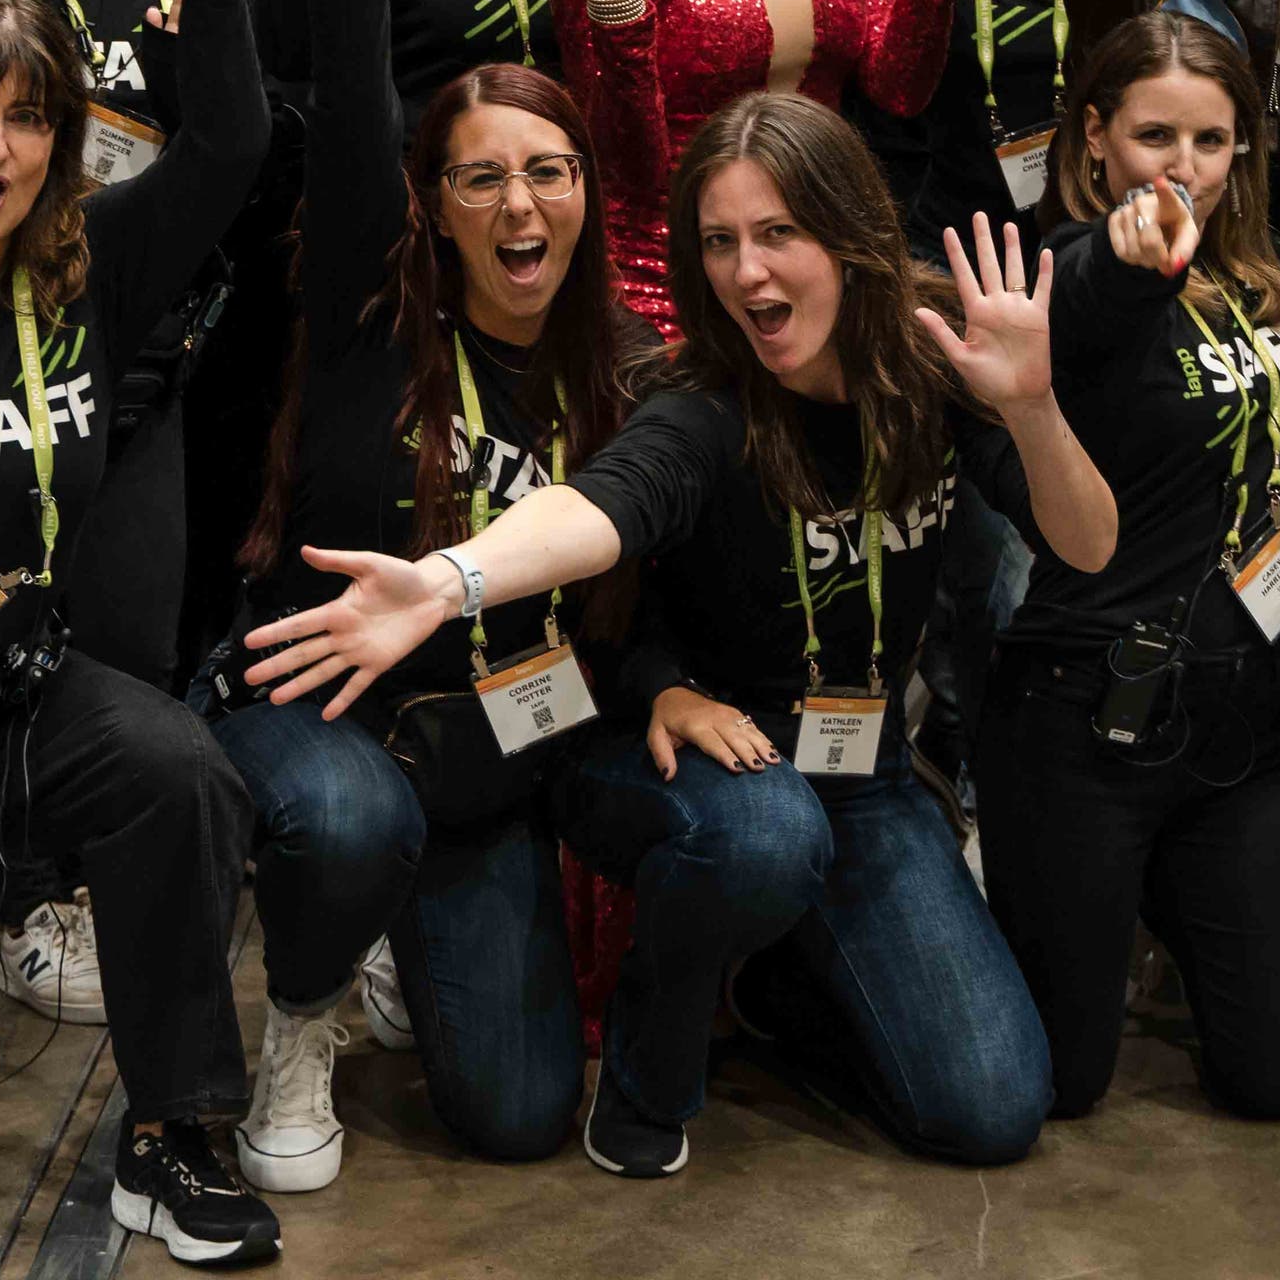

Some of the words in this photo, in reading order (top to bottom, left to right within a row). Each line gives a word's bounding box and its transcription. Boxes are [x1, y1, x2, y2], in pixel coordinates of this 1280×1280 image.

[99, 128, 135, 149] SUMMER
[1176, 348, 1205, 400] iapp
[509, 674, 553, 698] CORRINE
[516, 685, 553, 705] POTTER
[821, 717, 862, 726] KATHLEEN
[819, 728, 860, 736] BANCROFT
